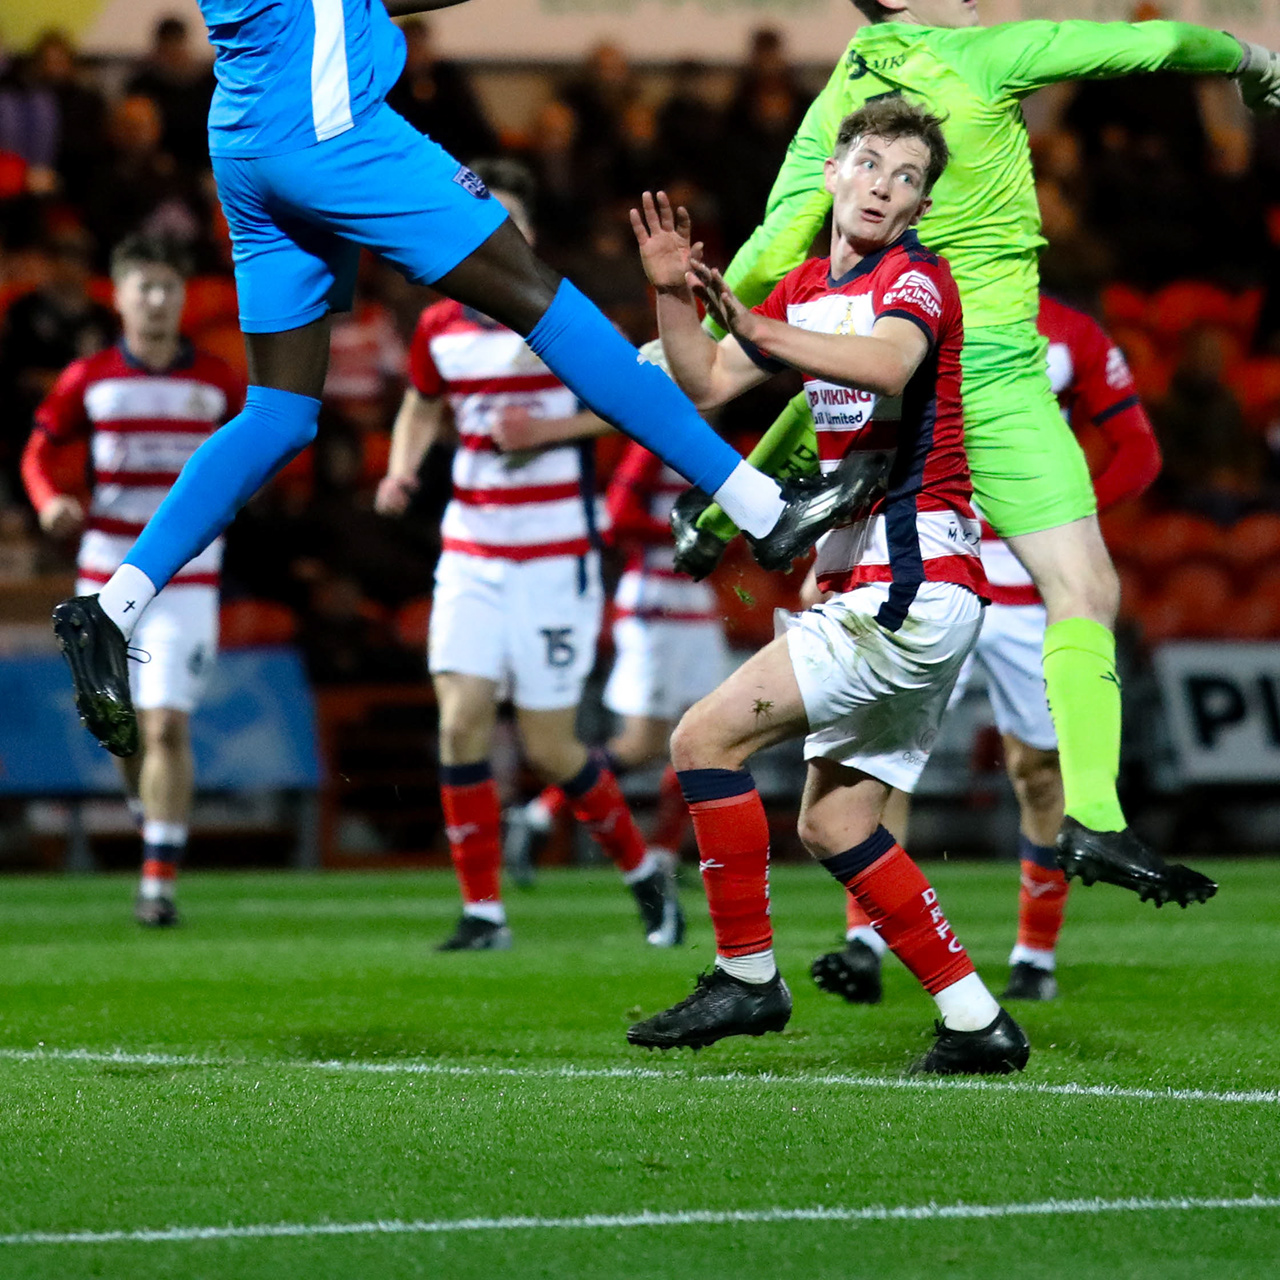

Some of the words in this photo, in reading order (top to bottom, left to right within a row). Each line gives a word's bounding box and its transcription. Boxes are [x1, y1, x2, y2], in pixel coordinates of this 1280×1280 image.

[883, 287, 942, 318] PLATINUM
[820, 388, 872, 405] VIKING
[540, 627, 575, 668] 15
